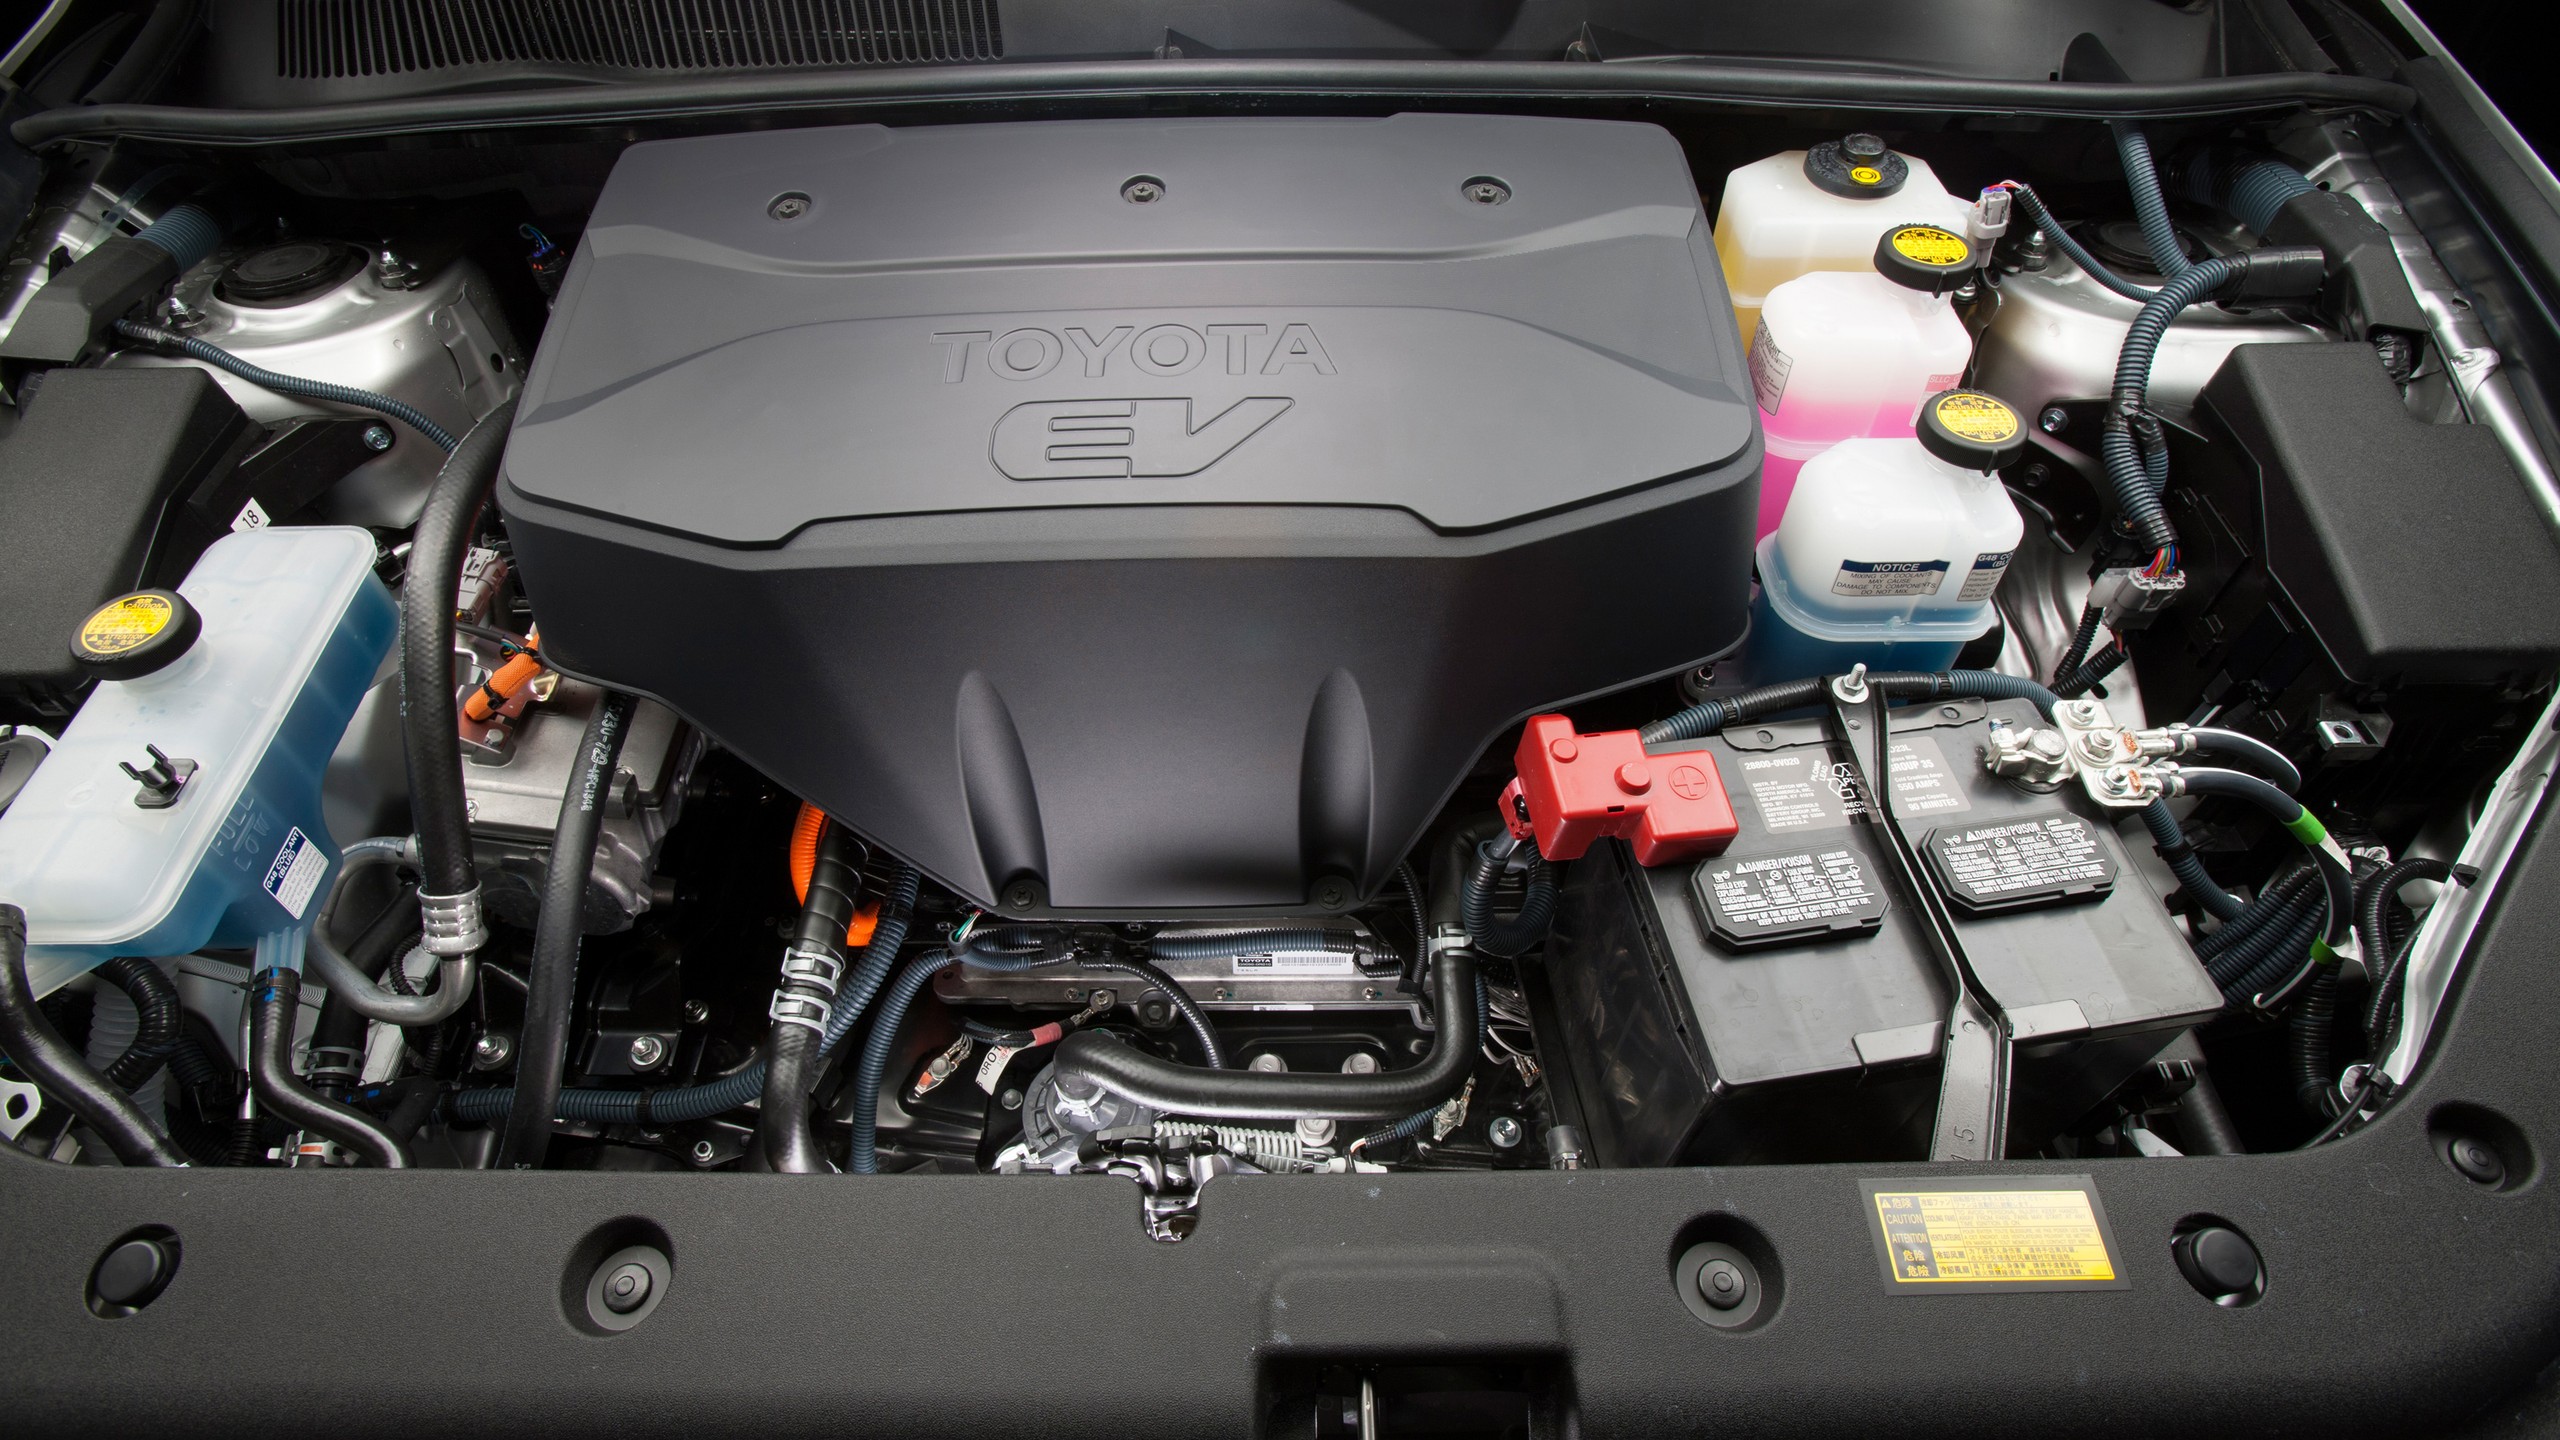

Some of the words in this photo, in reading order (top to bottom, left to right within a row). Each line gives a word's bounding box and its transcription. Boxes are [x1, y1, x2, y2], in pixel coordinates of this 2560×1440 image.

[930, 323, 1338, 384] TOYOTA
[988, 396, 1296, 482] EV
[1745, 758, 1800, 770] 28800-0V020
[1921, 759, 1935, 768] 35
[1897, 783, 1914, 791] 550
[1916, 779, 1941, 788] AMPS
[1908, 803, 1920, 811] 90
[1920, 799, 1958, 809] MINUTES
[1975, 823, 2040, 839] DANGER/POISON
[266, 871, 277, 888] G48
[276, 830, 299, 870] COOLANT
[278, 850, 295, 879] (BLUE)
[1745, 855, 1812, 872] DANGER/POISON
[1780, 907, 1800, 915] REACH
[1886, 1214, 1923, 1224] CAUTION
[1892, 1233, 1928, 1244] ATTENTION
